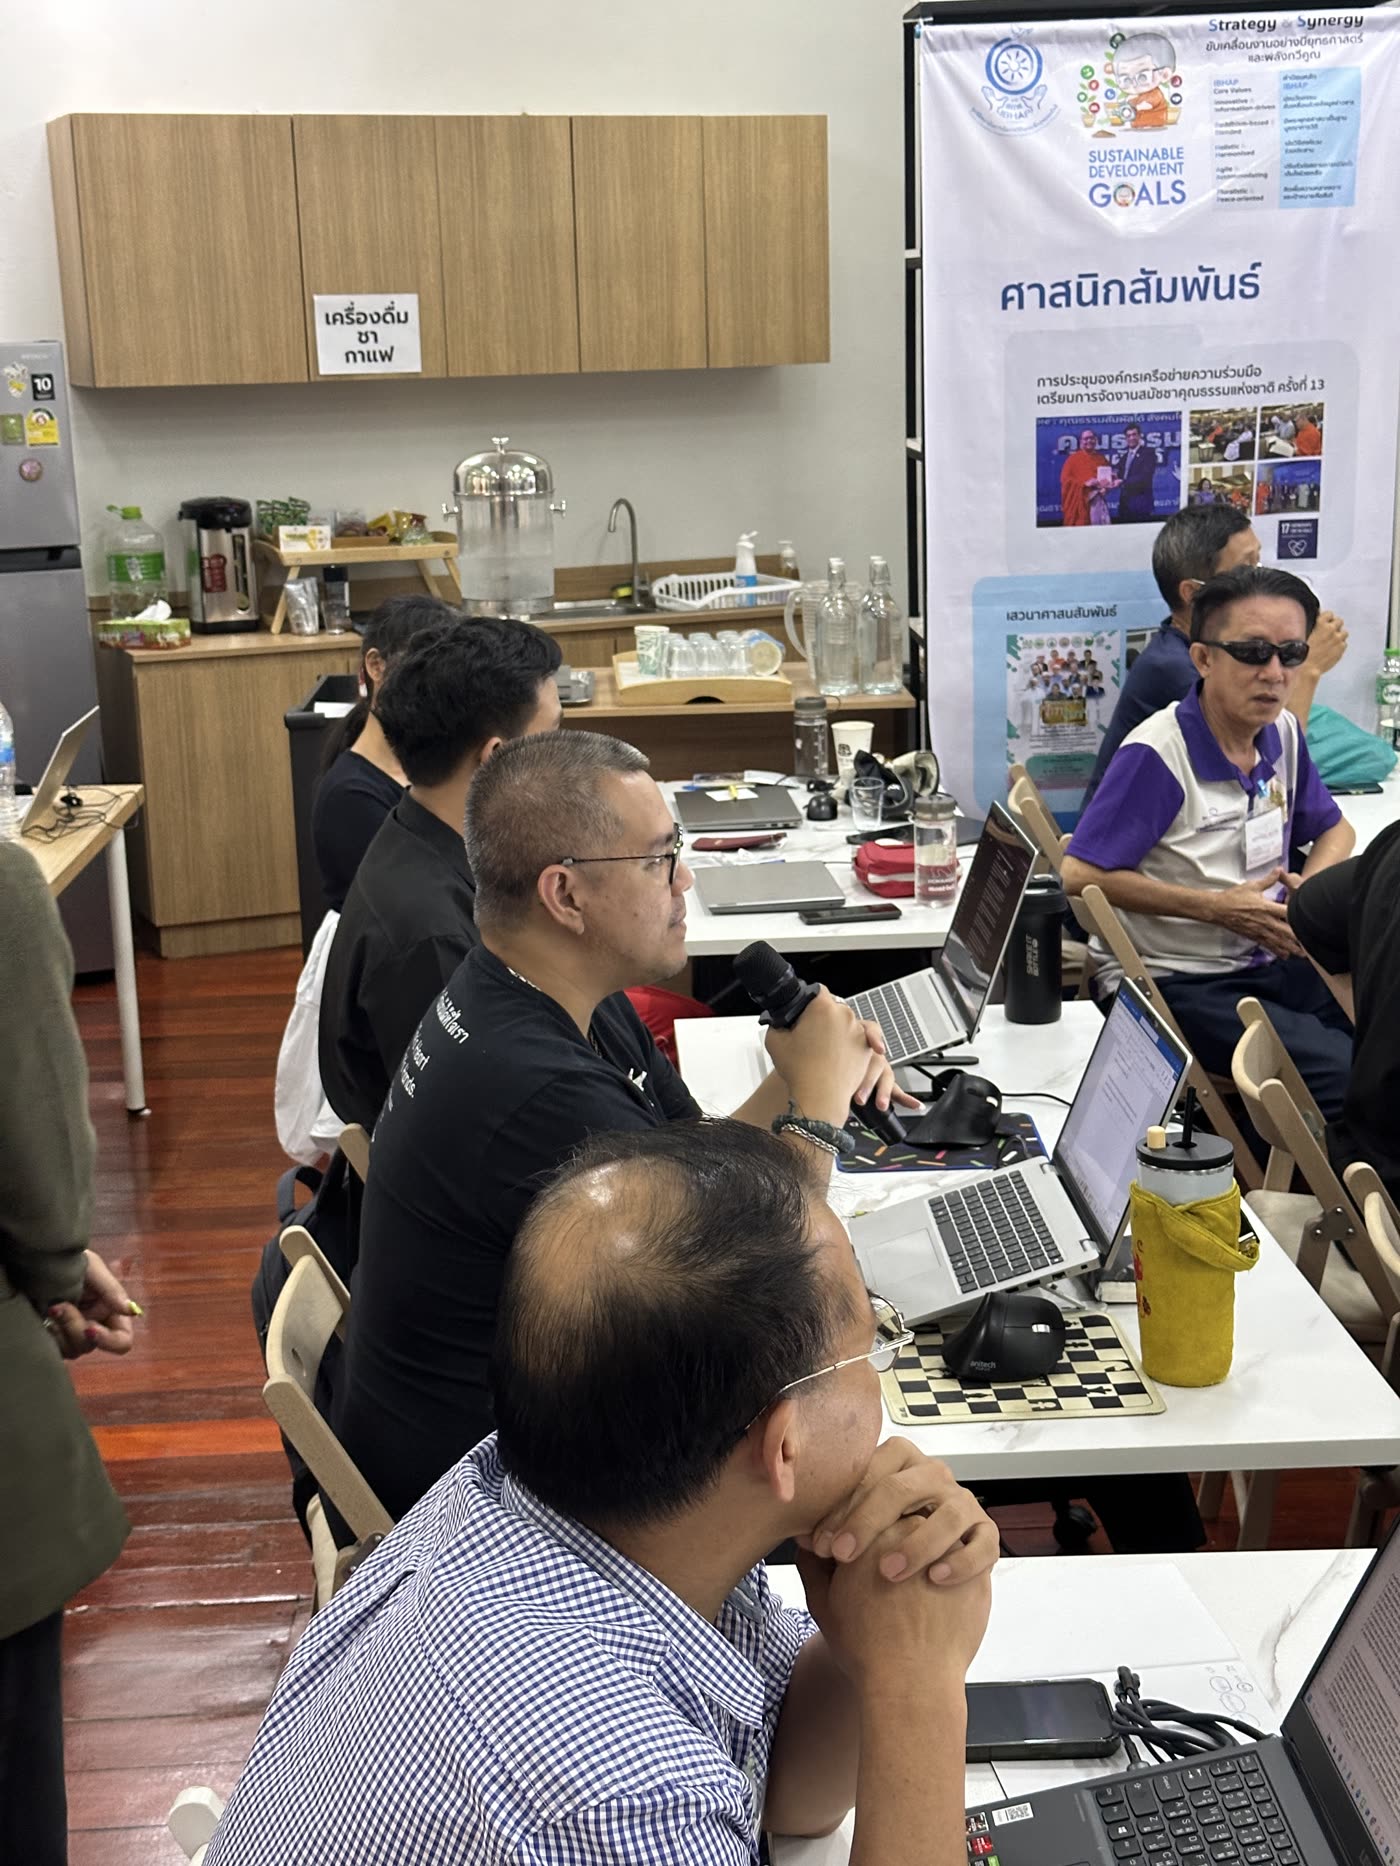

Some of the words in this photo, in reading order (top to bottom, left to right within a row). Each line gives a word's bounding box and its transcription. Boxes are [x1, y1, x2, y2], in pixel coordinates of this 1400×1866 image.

[1208, 18, 1277, 32] Strategy
[1297, 15, 1364, 30] Synergy
[1088, 146, 1184, 163] SUSTAINABLE
[1089, 162, 1184, 178] DEVELOPMENT
[1088, 179, 1186, 208] GOALS
[1001, 261, 1262, 311] ศาสนิกสัมพันธ์
[325, 301, 409, 325] เครื่องดื่ม
[357, 331, 378, 344] ชา
[345, 346, 394, 363] กาแฟ
[34, 377, 52, 391] 10
[1037, 364, 1262, 388] การประชุมองค์กรเครือข่ายความร่วมมือ
[1037, 381, 1275, 405] เตรียมการจัดงานสมัชชาคุณธรรมแห่งชาติ
[1277, 375, 1308, 393] ครั้งที่
[1310, 379, 1325, 391] 13
[1281, 523, 1290, 534] 17
[1006, 604, 1118, 622] เสวนาศาสนสัมพันธ์
